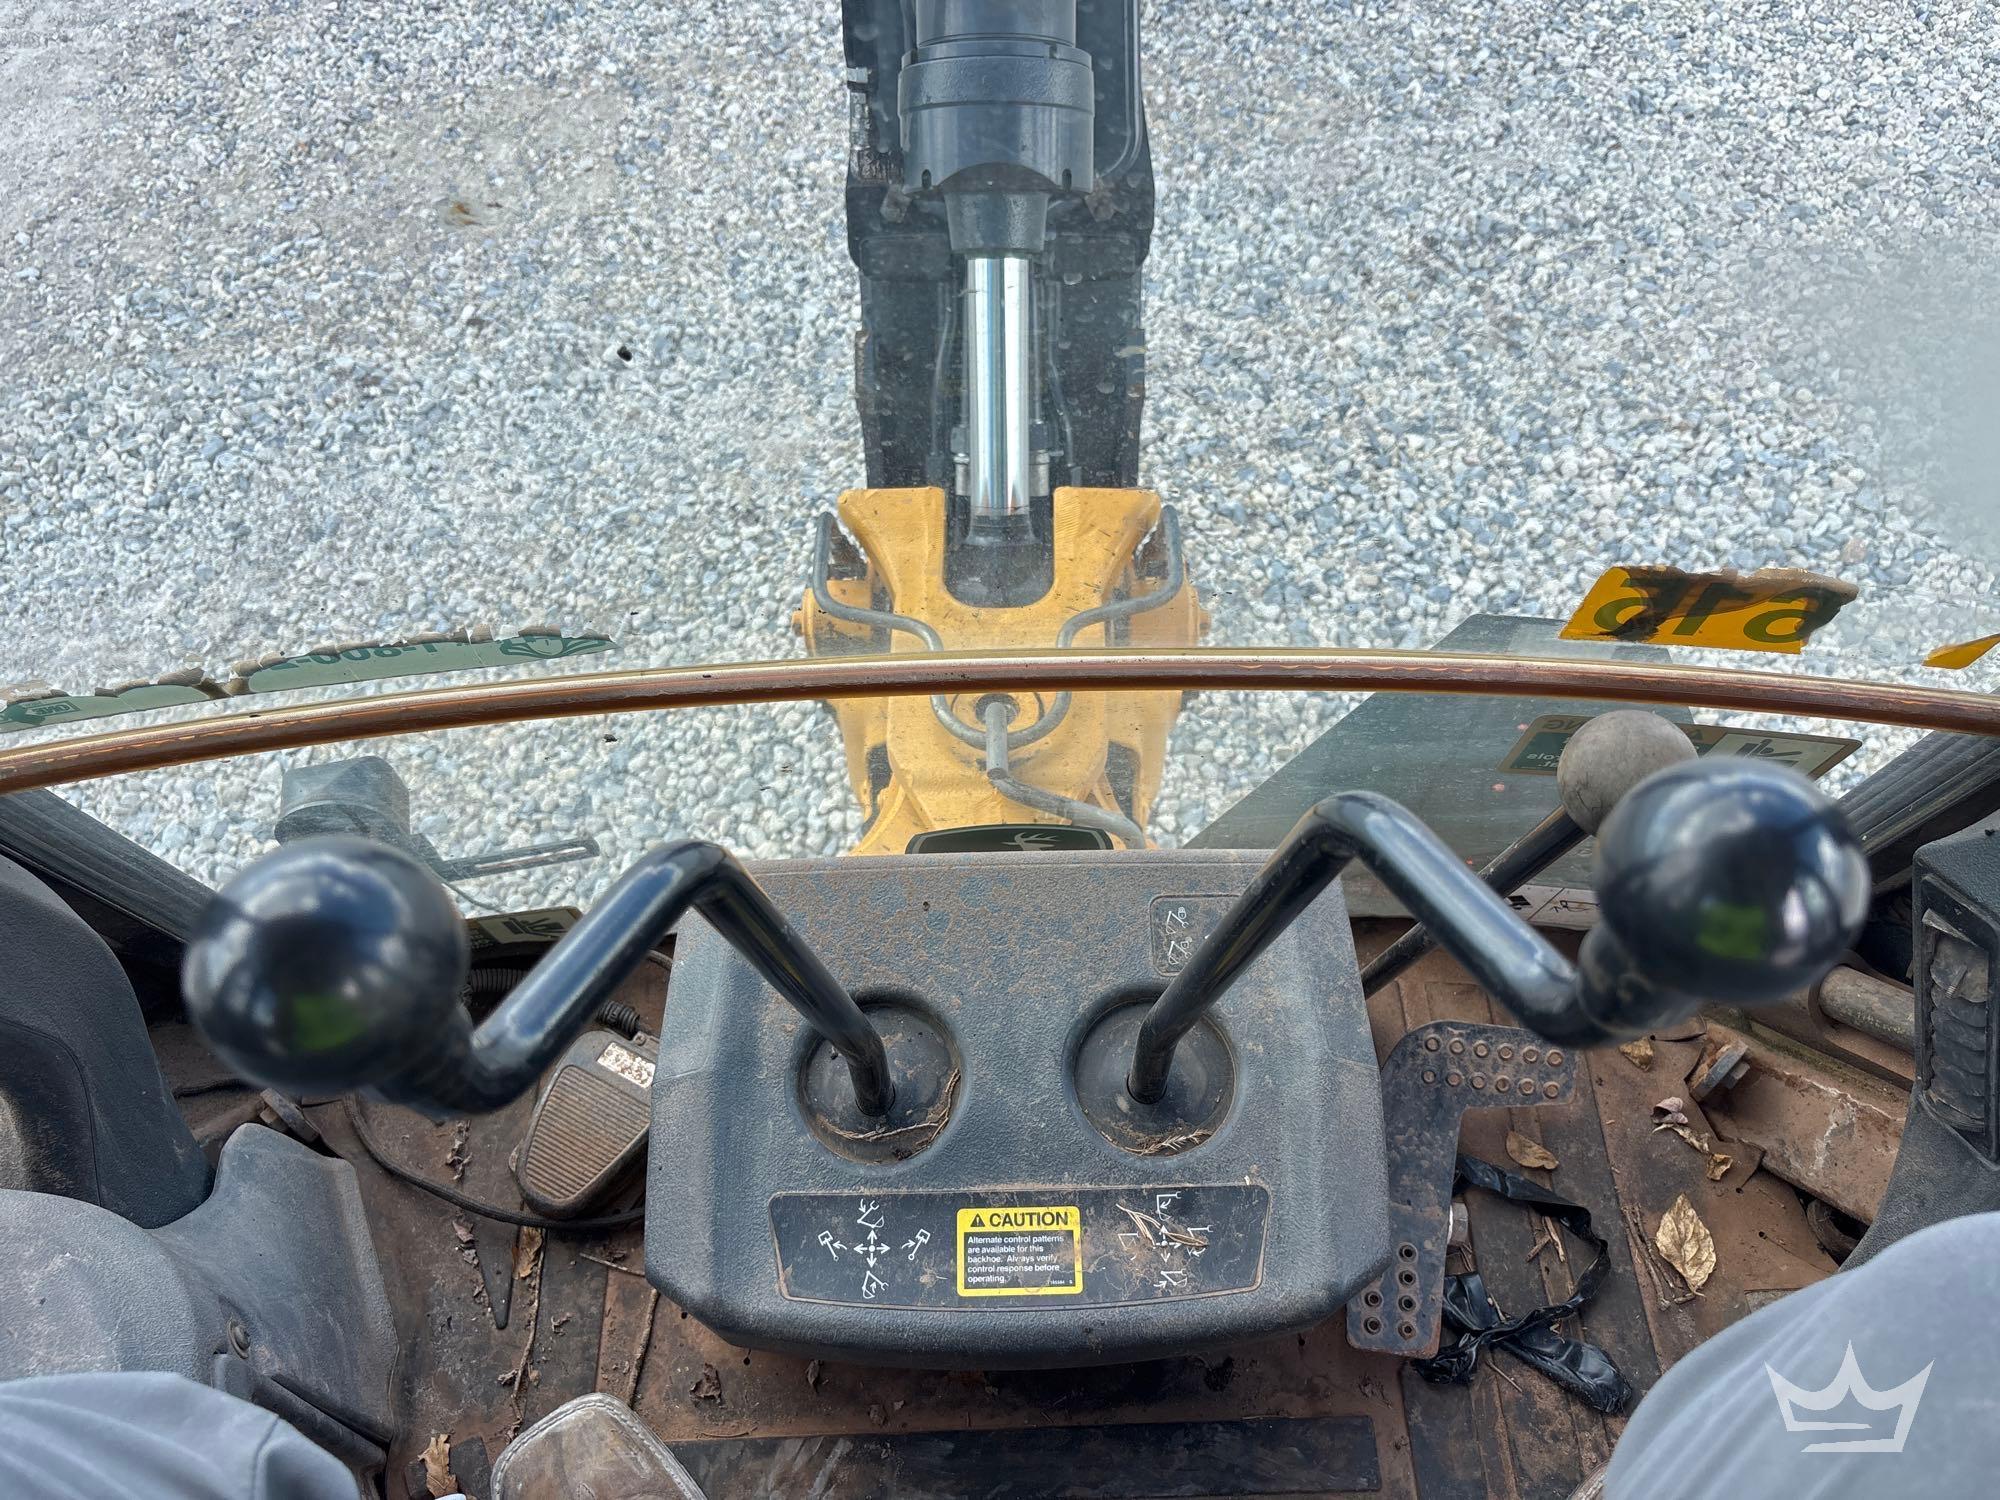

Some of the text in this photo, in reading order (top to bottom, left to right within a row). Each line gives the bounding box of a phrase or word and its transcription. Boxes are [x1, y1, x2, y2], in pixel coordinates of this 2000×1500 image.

[990, 1212, 1068, 1227] CAUTION
[968, 1236, 1002, 1244] Alternate
[1032, 1235, 1064, 1243] patterns
[1037, 1254, 1057, 1263] verify
[968, 1275, 1006, 1284] operating.
